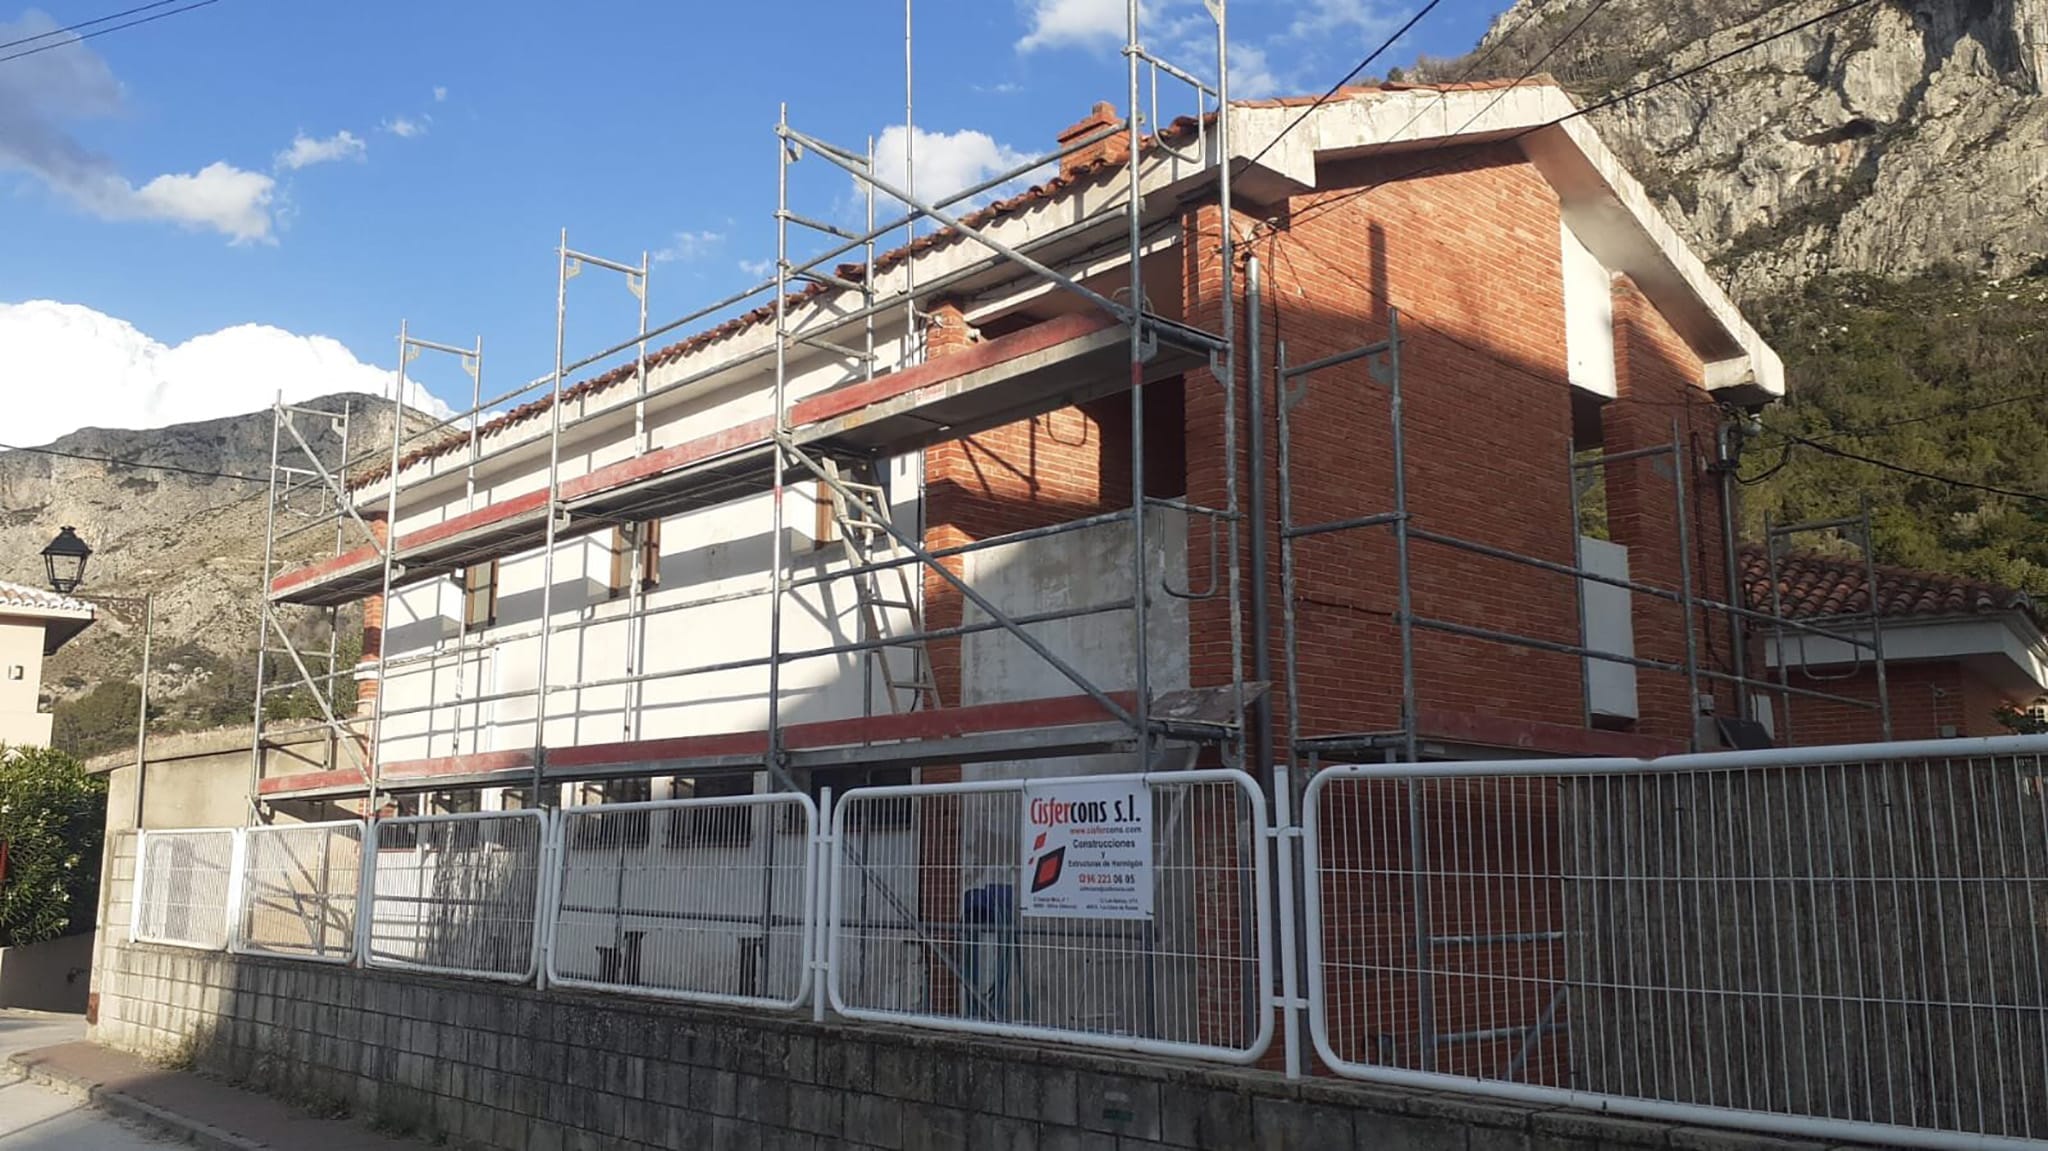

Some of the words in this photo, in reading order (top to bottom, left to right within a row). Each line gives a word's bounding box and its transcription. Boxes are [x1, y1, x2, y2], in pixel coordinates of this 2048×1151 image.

[1030, 797, 1108, 827] Cisfercons
[1114, 794, 1142, 822] s.l.
[1073, 839, 1136, 849] Construcciones
[1102, 860, 1110, 868] de
